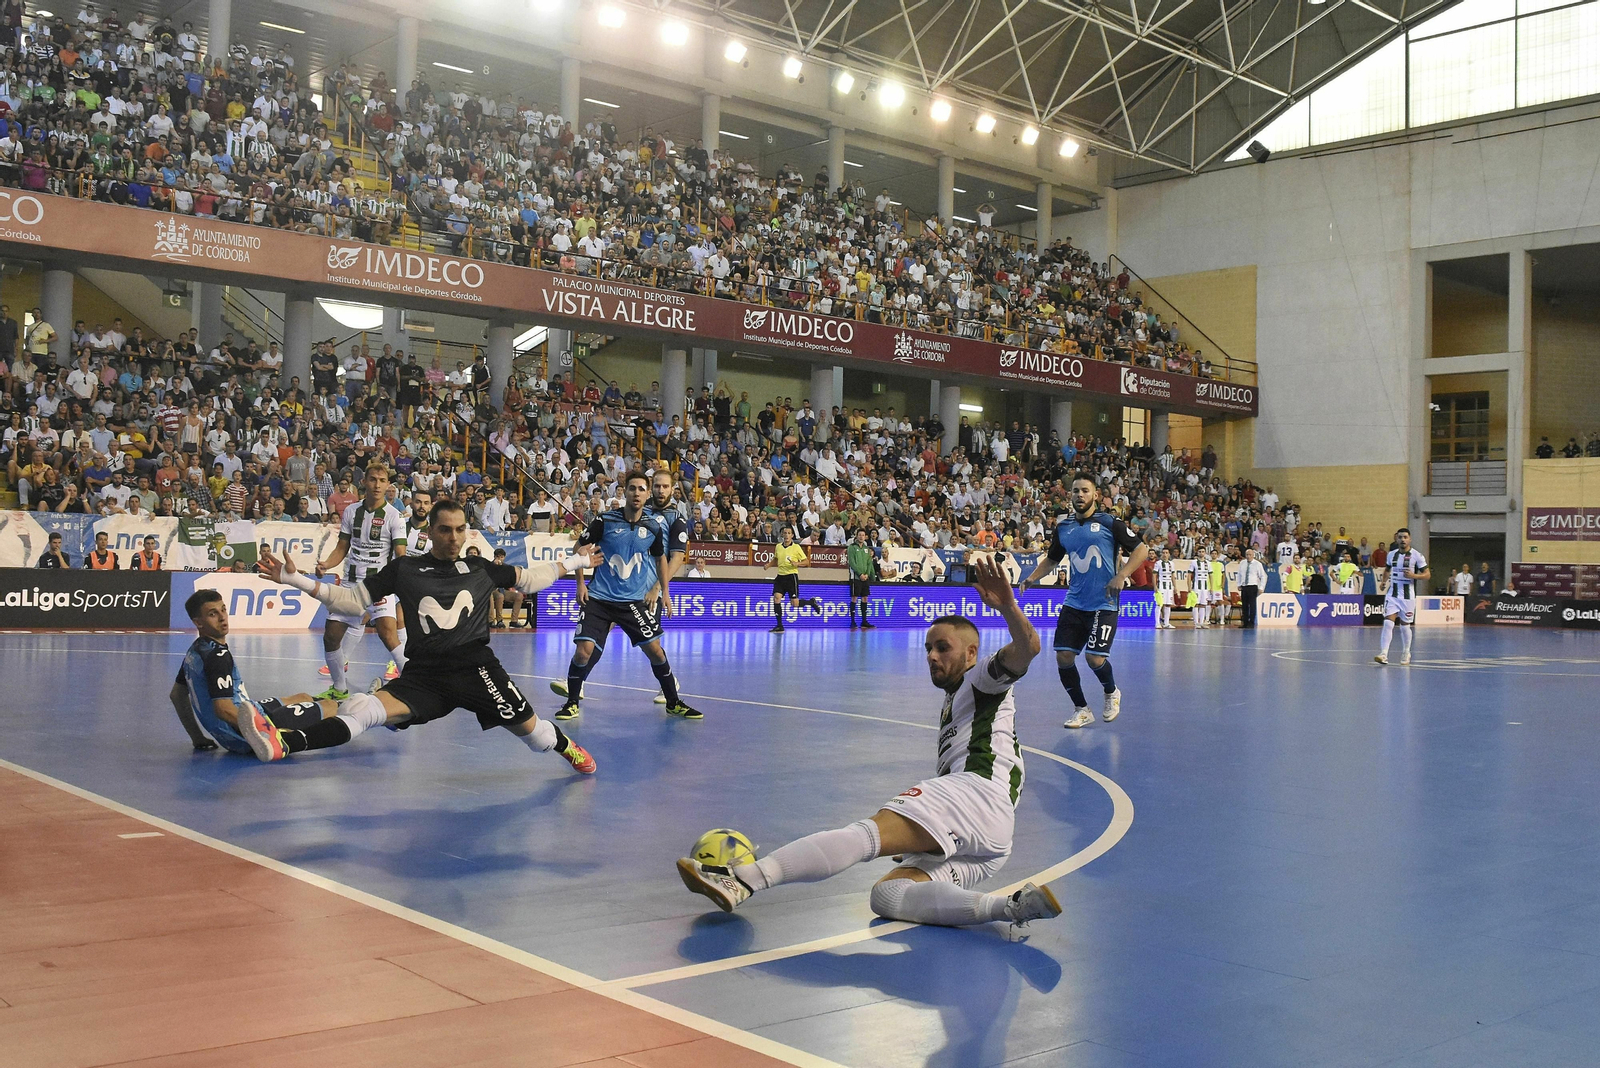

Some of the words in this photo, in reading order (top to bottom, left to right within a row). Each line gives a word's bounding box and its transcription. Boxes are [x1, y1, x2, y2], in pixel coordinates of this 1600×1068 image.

[482, 65, 490, 75] 8
[766, 134, 773, 144] 9
[987, 190, 996, 199] 10
[193, 228, 261, 250] AYUNTAMIENTO
[192, 243, 204, 257] DE
[206, 245, 250, 263] CÓRDOBA
[365, 248, 484, 288] IMDECO
[327, 273, 360, 285] Instituto
[362, 278, 401, 292] Municipal
[402, 284, 413, 293] de
[414, 285, 449, 298] Deportes
[450, 290, 482, 302] Córdoba
[552, 277, 592, 291] PALACIO
[594, 284, 641, 299] MUNICIPAL
[644, 292, 685, 306] DEPORTES
[169, 295, 181, 306] G
[541, 289, 605, 319] VISTA
[612, 300, 696, 332] ALEGRE
[770, 311, 854, 343] IMDECO
[578, 345, 586, 356] H
[743, 333, 767, 343] Instituto
[768, 336, 795, 348] Municipal
[796, 340, 804, 348] de
[804, 341, 829, 353] Deportes
[829, 345, 852, 355] Córdoba
[914, 338, 951, 353] AYUNTAMIENTO
[914, 349, 920, 358] DE
[920, 350, 945, 362] CÓRDOBA
[1020, 351, 1083, 378] IMDECO
[999, 370, 1017, 379] Instituto
[1018, 372, 1039, 382] Municipal
[1045, 376, 1064, 387] Deportes
[1065, 379, 1082, 388] Córdoba
[1139, 376, 1170, 389] Diputación
[1139, 386, 1147, 395] de
[1148, 386, 1170, 398] Córdoba
[1209, 383, 1253, 404] IMDECO
[1101, 414, 1106, 422] J
[694, 549, 722, 558] IMDECO
[813, 553, 837, 561] IMDECO
[1281, 546, 1292, 557] 13
[711, 600, 737, 616] en
[908, 597, 956, 622] Sigue
[961, 597, 976, 616] la
[1023, 602, 1042, 617] en
[1441, 598, 1460, 610] SEUR
[1100, 624, 1112, 641] 17
[507, 680, 522, 701] 1
